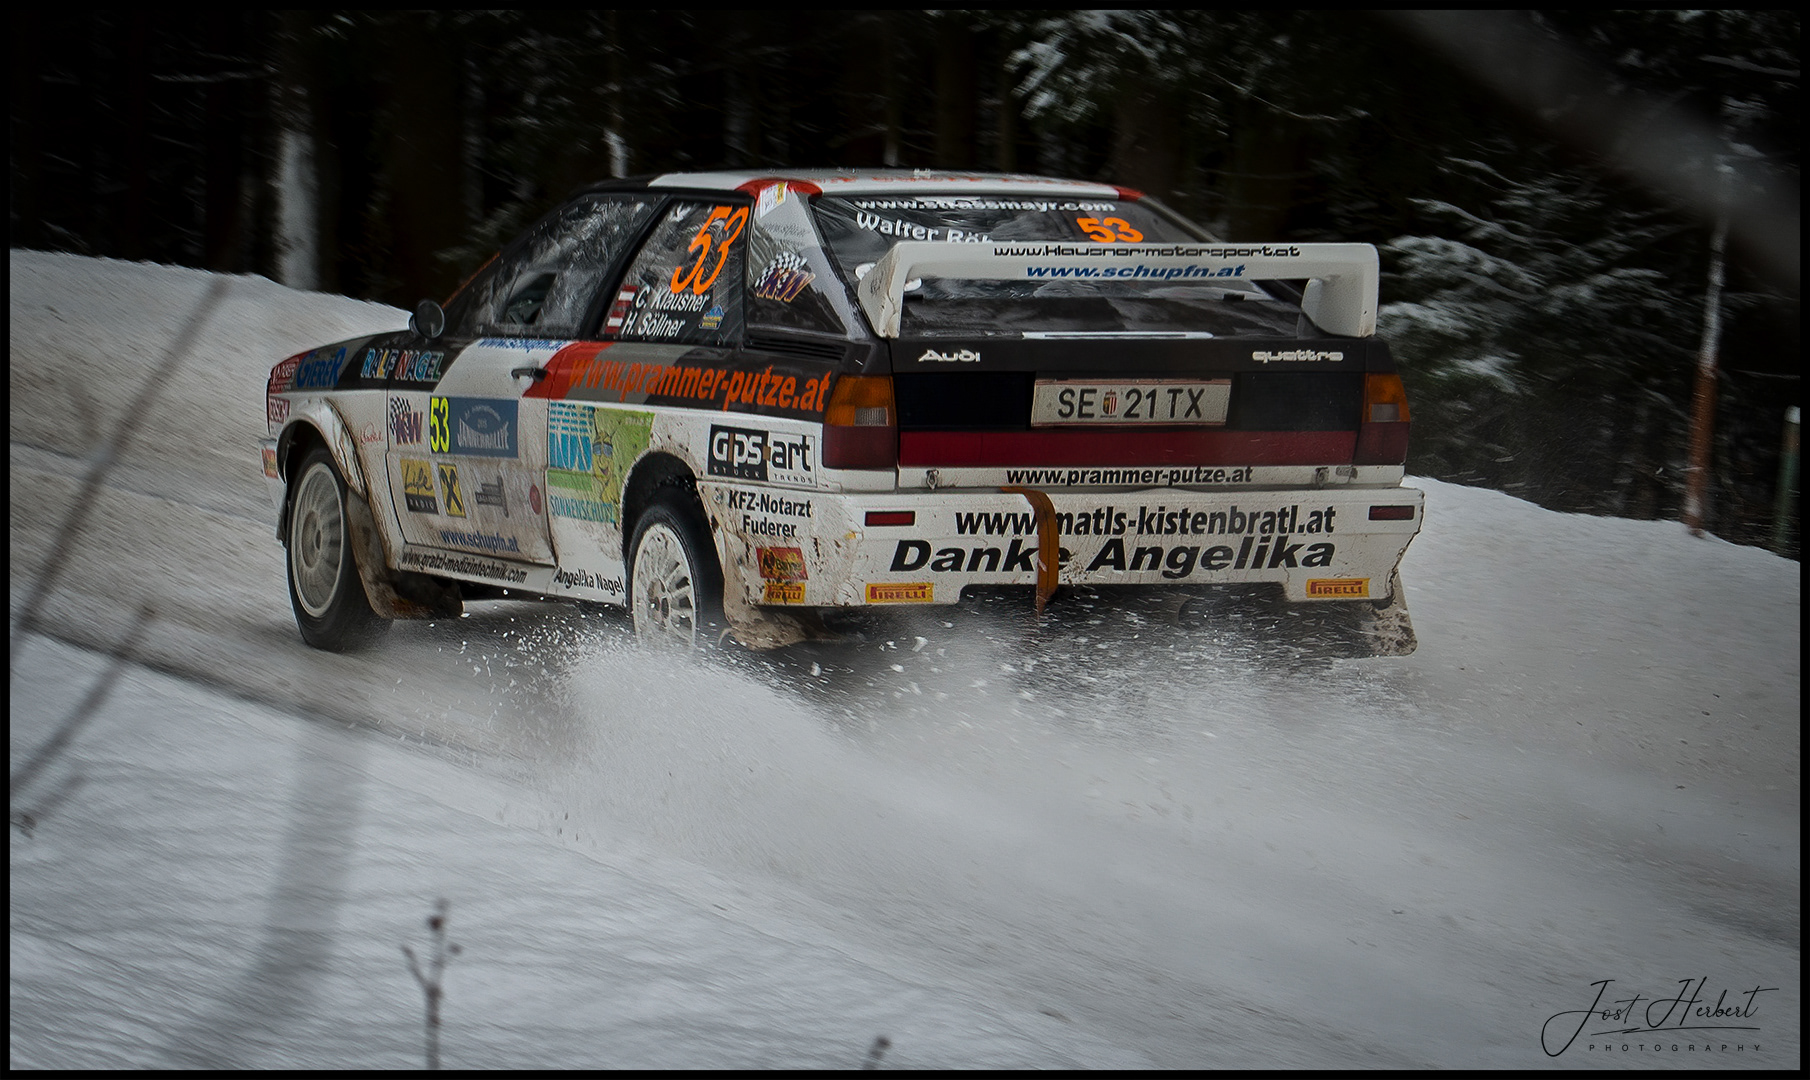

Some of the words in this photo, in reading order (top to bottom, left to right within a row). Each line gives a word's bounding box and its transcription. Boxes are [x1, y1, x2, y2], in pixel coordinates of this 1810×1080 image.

[856, 211, 939, 242] Walter
[947, 228, 1016, 242] Röh
[1076, 217, 1144, 243] 53
[671, 205, 749, 295] 53
[1027, 264, 1245, 280] www.schupfn.at
[636, 285, 650, 308] C.
[651, 286, 710, 312] Klausner
[621, 311, 638, 335] H.
[638, 311, 686, 337] Söllner
[360, 347, 399, 380] RALF
[394, 350, 445, 382] NAGEL
[918, 349, 980, 362] Audi
[1252, 349, 1344, 363] quattro
[568, 358, 832, 412] www.prammer-putze.at
[1057, 388, 1097, 418] SE
[1123, 388, 1157, 418] 21
[1167, 388, 1205, 419] TX
[430, 397, 450, 453] 53
[771, 435, 812, 472] art
[713, 465, 760, 479] STUCK
[773, 473, 814, 484] TRENDS
[1006, 465, 1253, 486] www.prammer-putze.at
[728, 489, 812, 518] KFZ-Notarzt
[743, 515, 798, 537] Fuderer
[955, 505, 1336, 535] wwwmatls-kistenbratl.at
[440, 529, 520, 554] www.schupfn.at
[1085, 535, 1336, 579] Angelika
[553, 566, 595, 589] Angelika
[595, 572, 626, 597] Nagel
[870, 585, 927, 600] PIRELLI
[1310, 581, 1363, 595] PIRELLI
